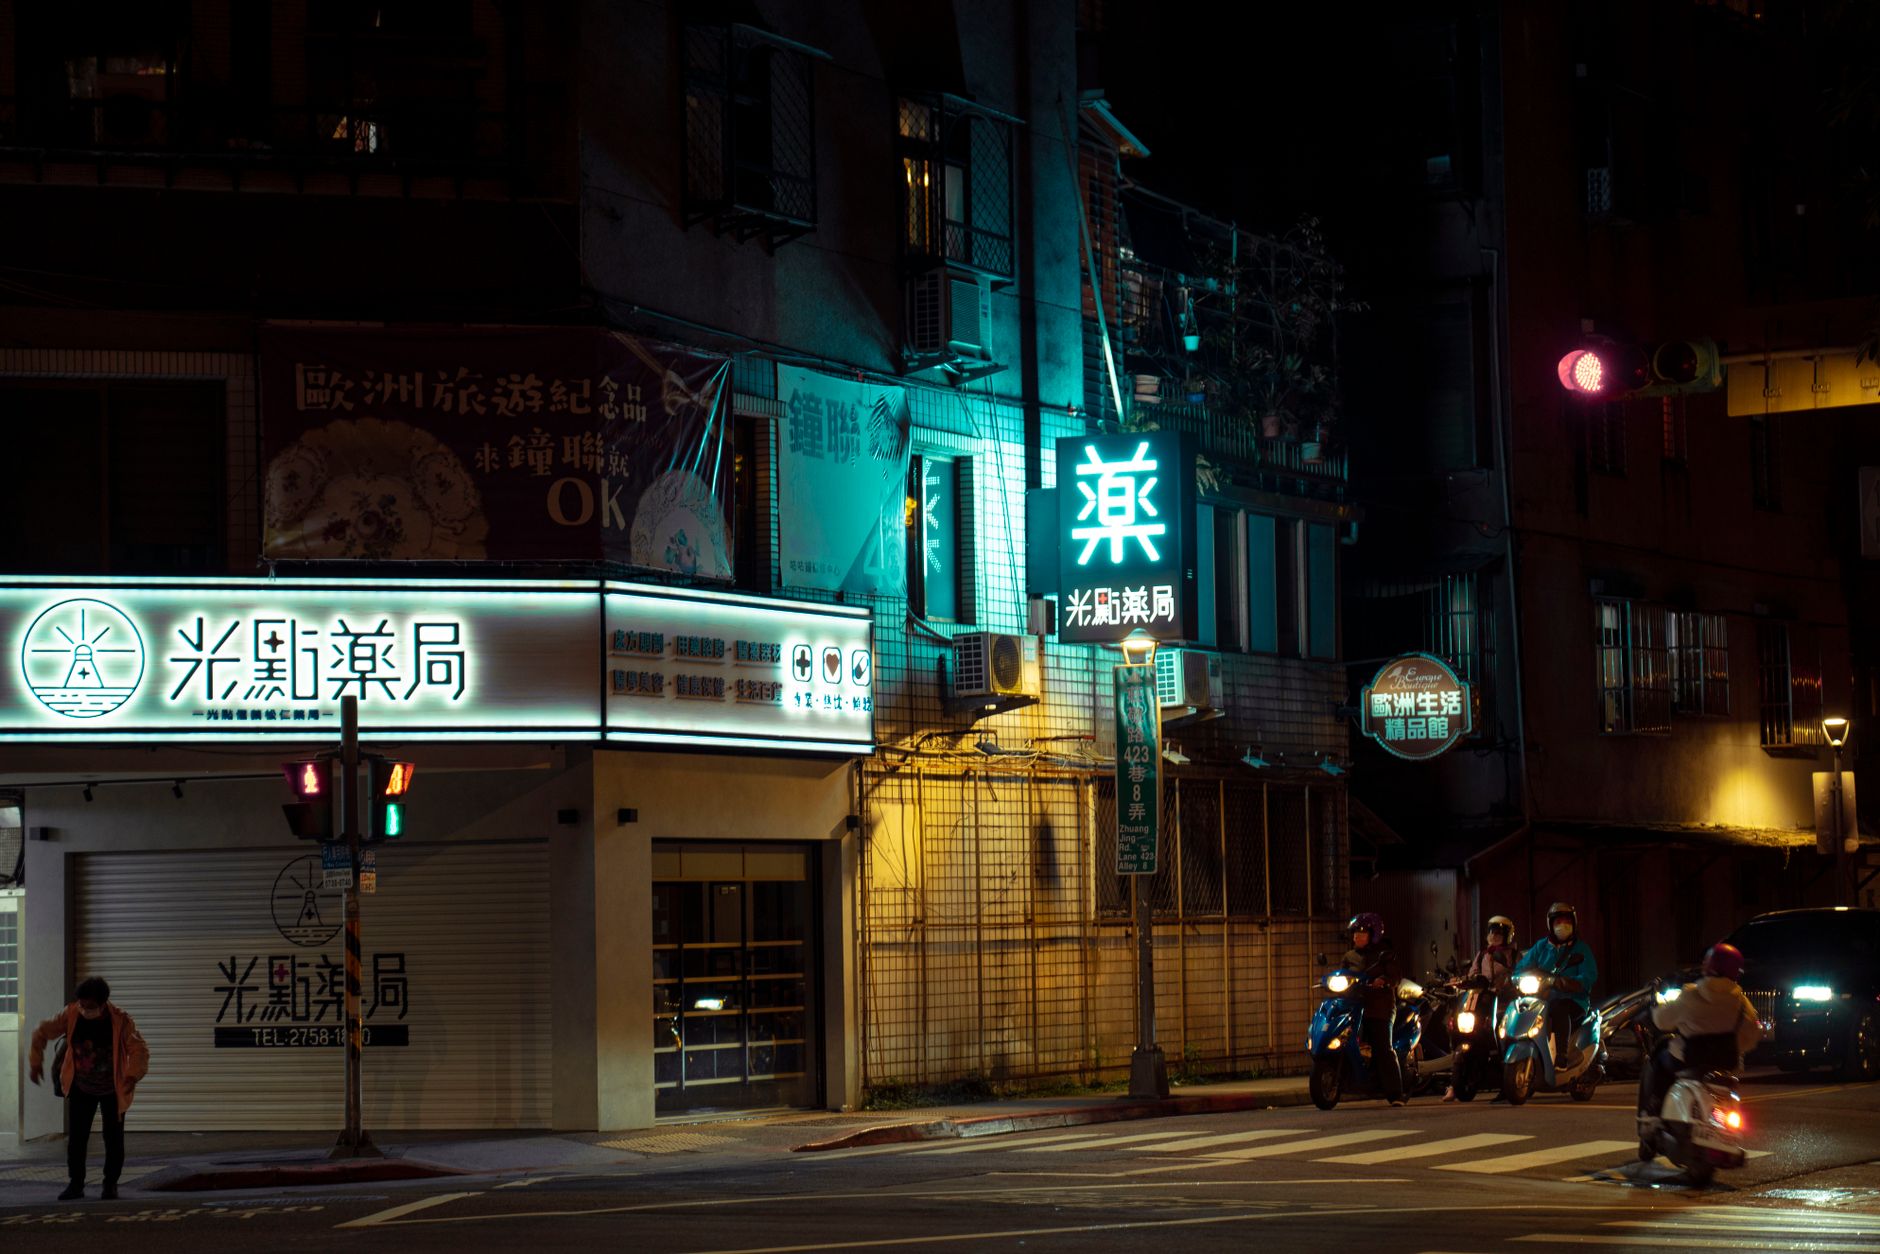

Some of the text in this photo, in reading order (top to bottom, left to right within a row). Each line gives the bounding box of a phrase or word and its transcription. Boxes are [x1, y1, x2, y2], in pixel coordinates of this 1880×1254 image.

[296, 362, 648, 424] 歐洲旅遊紀念品
[474, 426, 630, 479] 來鐘聯就
[546, 477, 626, 531] OK
[1371, 690, 1462, 717] 歐洲生活
[1385, 717, 1449, 740] 精品館
[1119, 824, 1149, 834] Zhuang
[1119, 834, 1136, 844] Jing
[1118, 852, 1154, 862] Lane 423
[1118, 862, 1138, 871] Alley
[251, 1027, 371, 1047] TEL:2758-10
